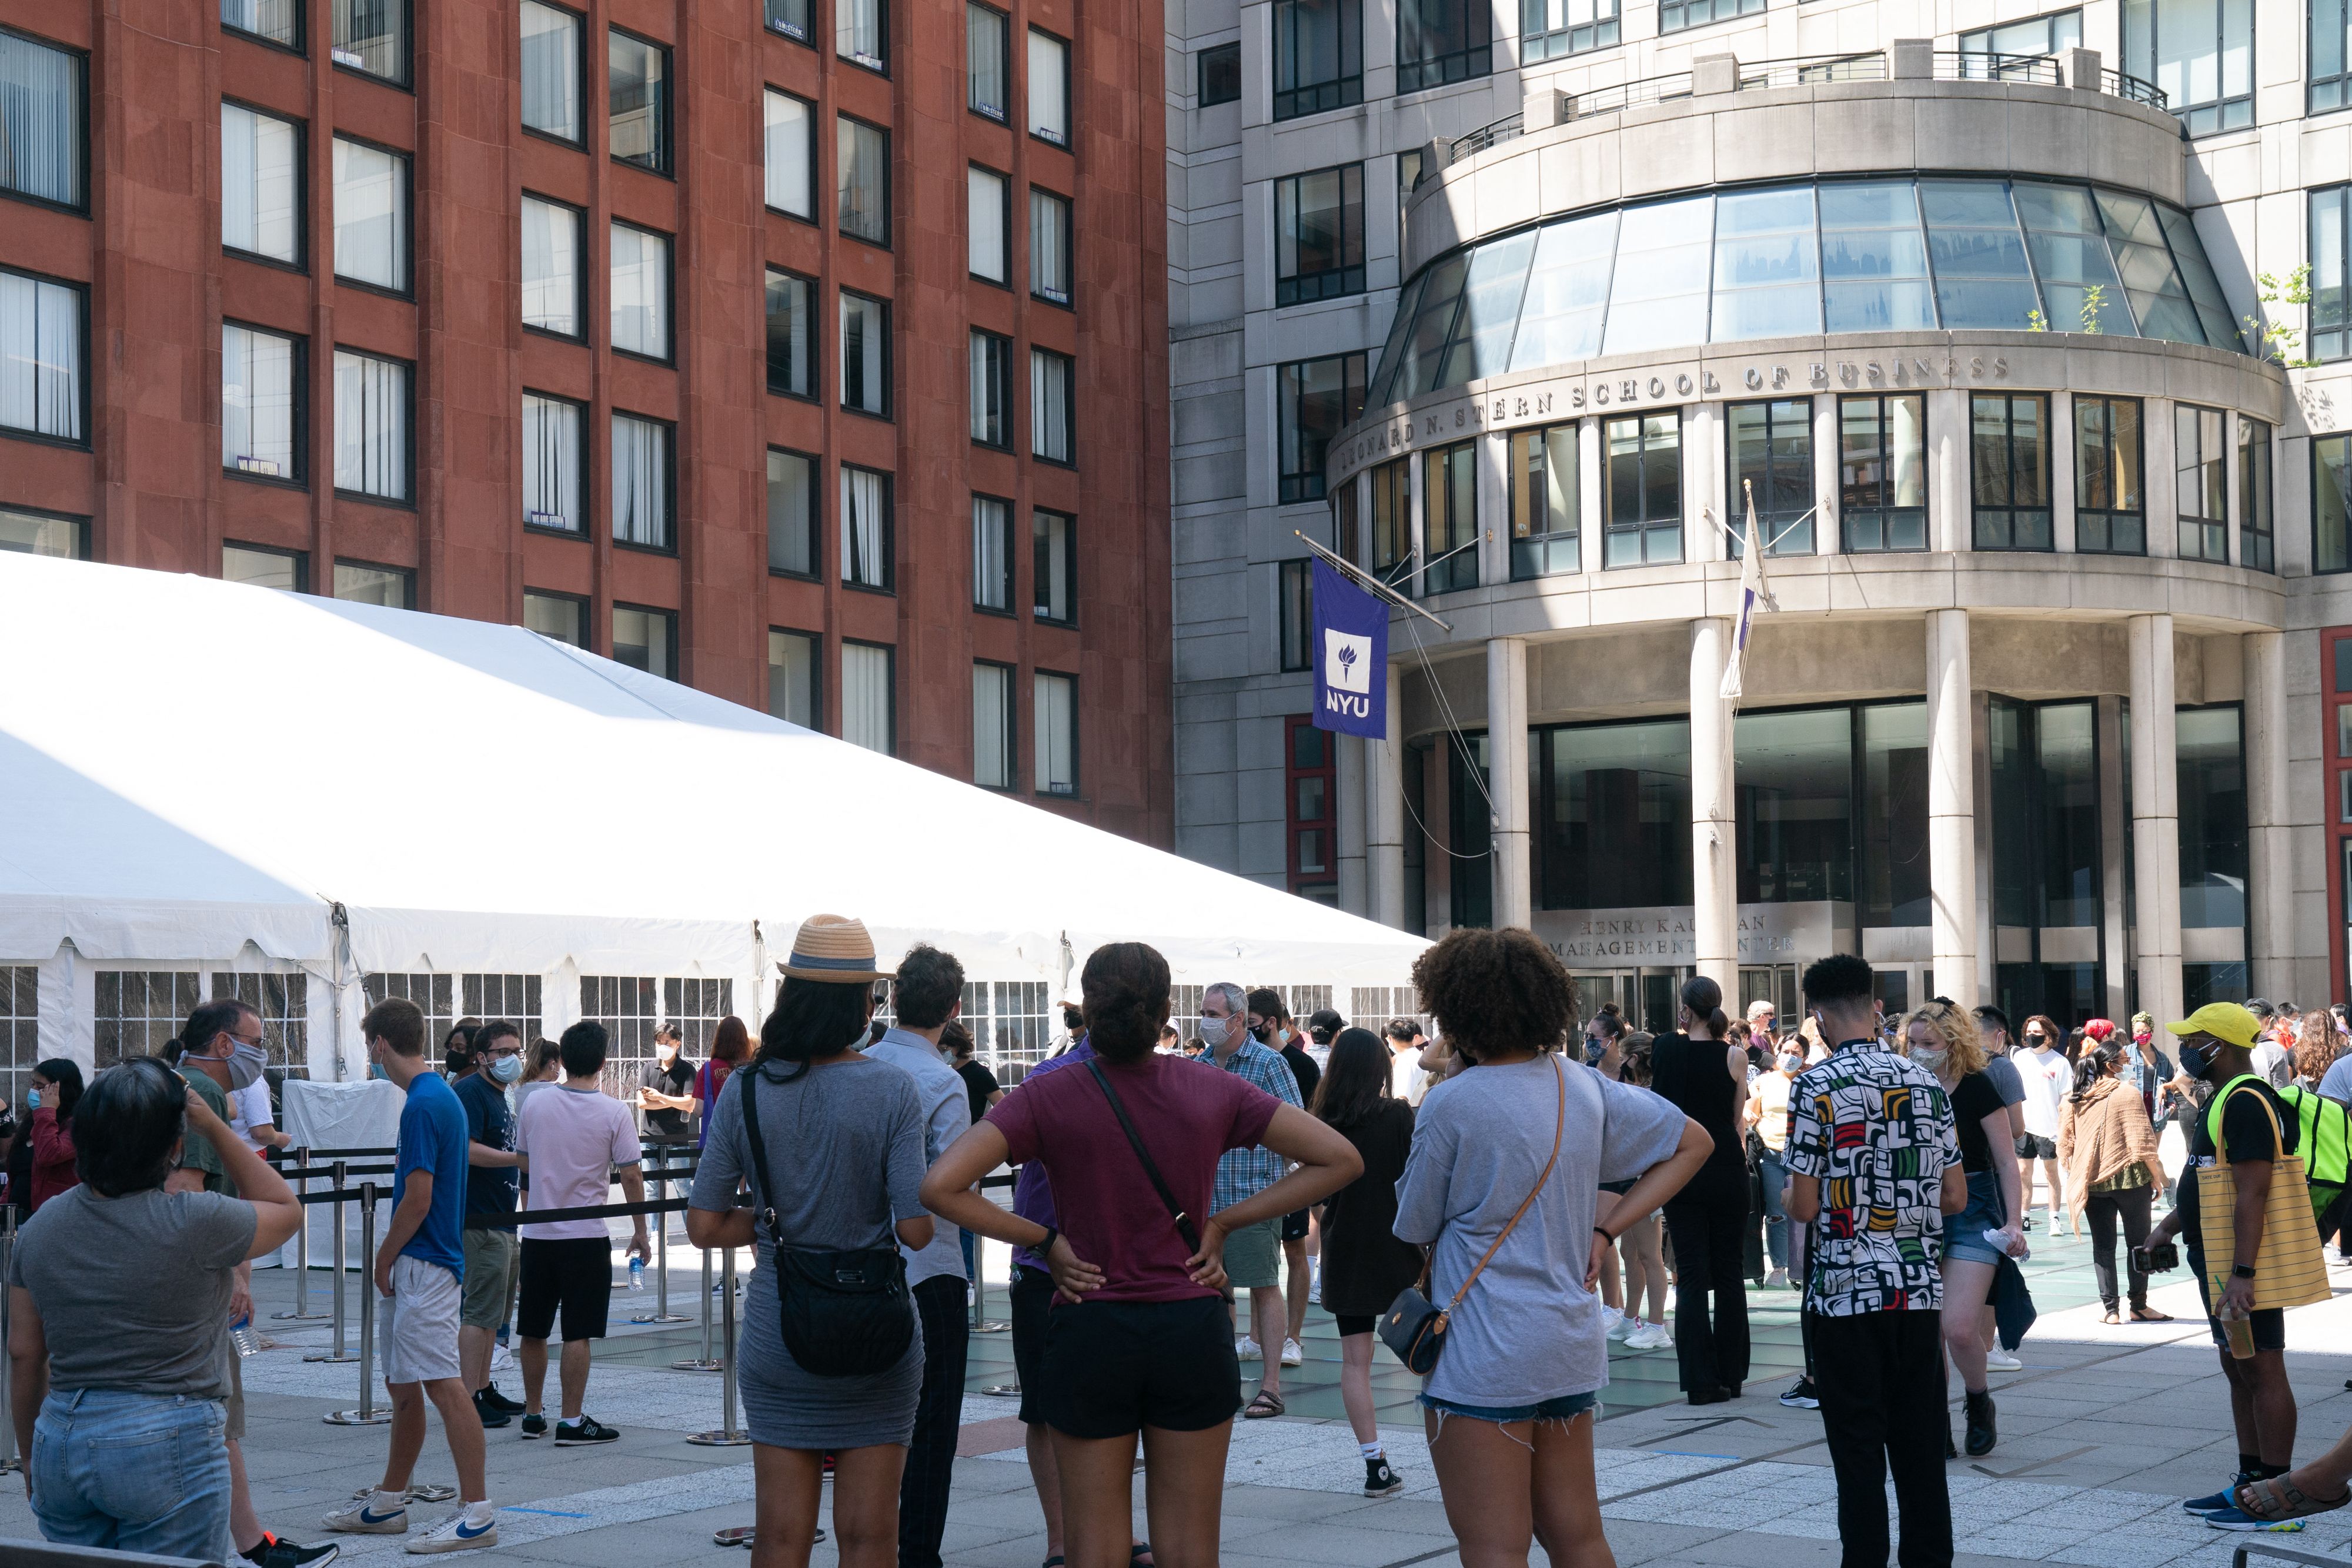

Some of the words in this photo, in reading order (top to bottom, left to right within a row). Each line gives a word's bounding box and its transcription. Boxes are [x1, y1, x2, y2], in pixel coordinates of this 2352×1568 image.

[1426, 415, 1444, 434] N.
[1455, 392, 1553, 428] STERN
[1572, 371, 1720, 408] SCHOOL
[1742, 365, 1788, 388] OF
[1808, 356, 2008, 382] BUSINESS
[238, 459, 248, 471] WE
[249, 460, 259, 473] ARE
[260, 460, 279, 476] STERN
[532, 514, 540, 525] WE
[540, 514, 549, 527] ARE
[549, 515, 564, 529] STERN
[1327, 688, 1369, 718] NYU
[1580, 920, 1646, 935] HENRY
[1657, 915, 1765, 932] KAUAN
[1549, 940, 1696, 956] MANAGEMENT
[1737, 936, 1795, 952] NTER
[584, 1424, 598, 1436] N
